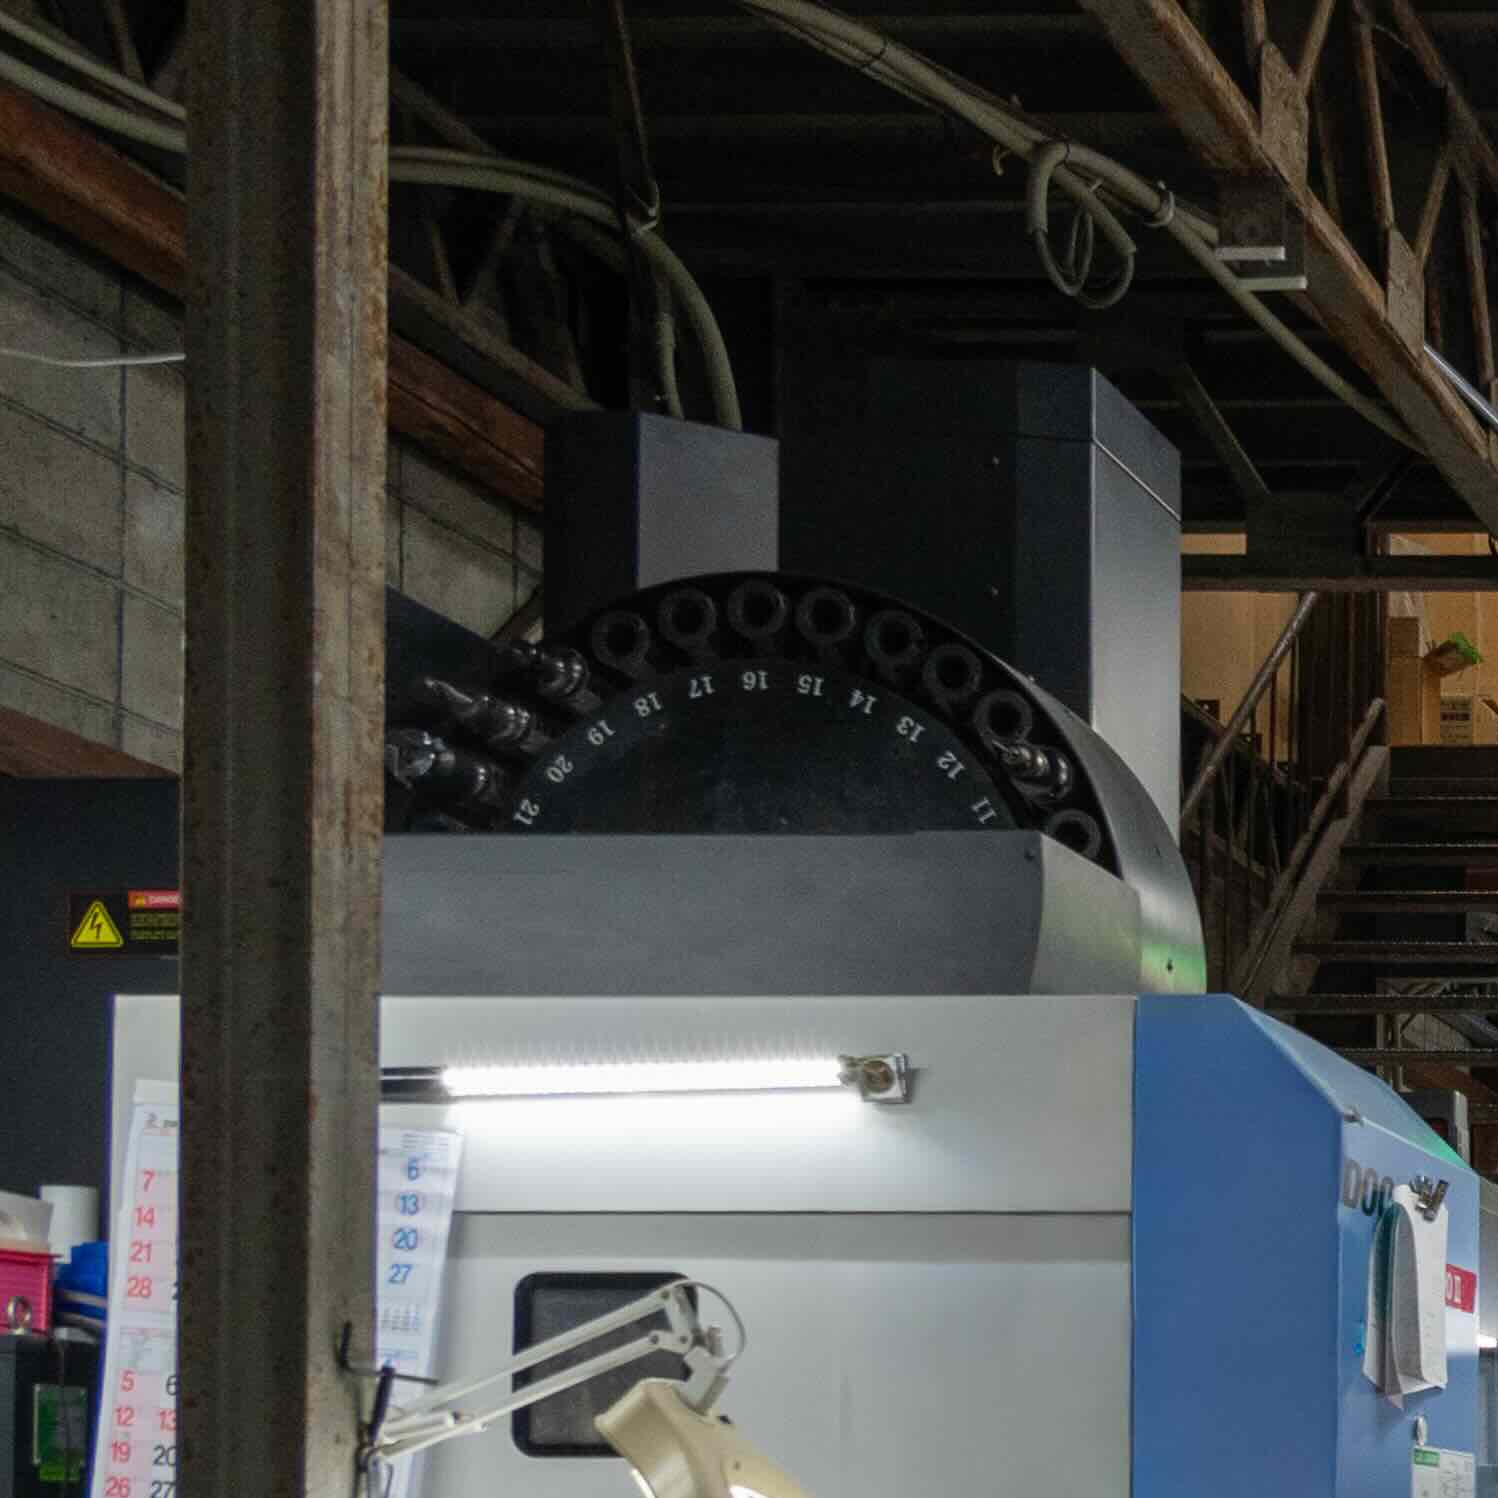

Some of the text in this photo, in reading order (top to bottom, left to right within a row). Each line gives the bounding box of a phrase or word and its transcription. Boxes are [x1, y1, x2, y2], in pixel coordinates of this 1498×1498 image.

[689, 676, 716, 700] 17
[740, 669, 768, 692] 16
[797, 672, 824, 696] 15
[633, 692, 663, 719] 18
[849, 688, 878, 715] 14
[586, 720, 616, 747] 19
[895, 716, 923, 743] 13
[544, 758, 575, 785] 20
[939, 752, 967, 779] 12
[514, 798, 541, 825] 21
[970, 798, 996, 824] 11
[406, 1157, 419, 1181] 6
[142, 1170, 155, 1192] 7
[400, 1193, 419, 1216] 13
[135, 1207, 155, 1228] 14
[393, 1227, 418, 1250] 20
[130, 1242, 152, 1263] 21
[387, 1263, 414, 1285] 27
[127, 1276, 153, 1298] 28
[121, 1370, 134, 1392] 5
[115, 1407, 134, 1426] 12
[111, 1441, 130, 1462] 19
[104, 1477, 130, 1498] 26
